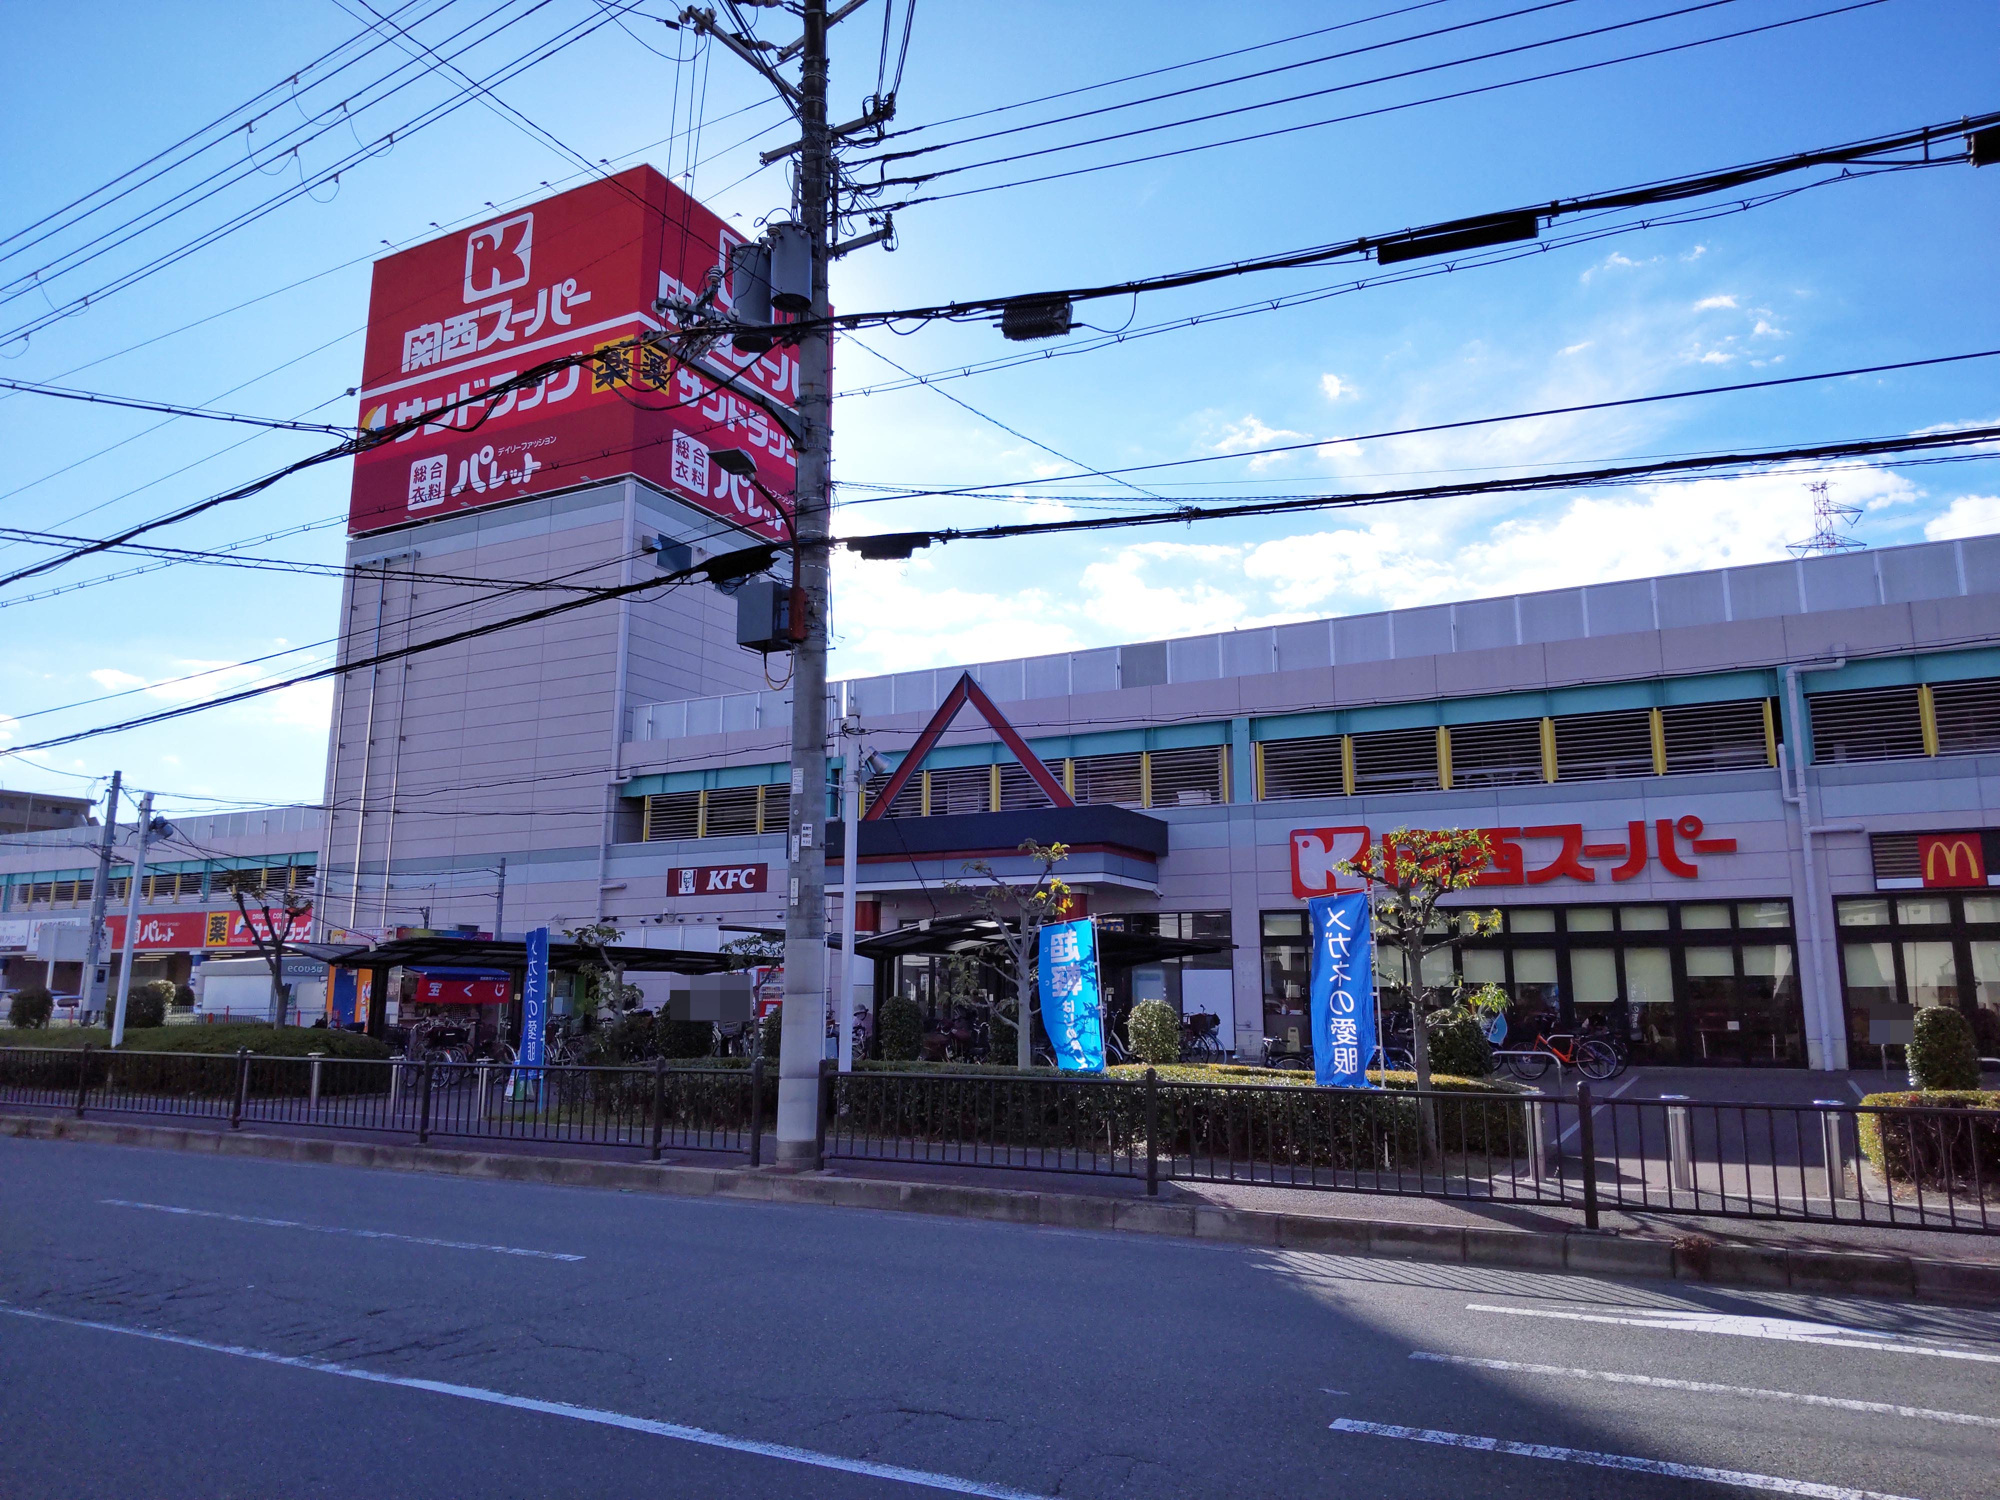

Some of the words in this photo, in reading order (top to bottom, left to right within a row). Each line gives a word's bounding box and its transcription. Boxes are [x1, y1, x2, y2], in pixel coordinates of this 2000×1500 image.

[401, 278, 591, 373] 関西スーパー
[497, 435, 558, 457] デイリーファッション
[675, 437, 706, 470] 総合
[413, 460, 444, 484] 総合
[451, 445, 542, 497] パレット
[674, 460, 706, 490] 衣料
[412, 483, 443, 504] 衣料
[706, 868, 756, 891] KFC
[141, 920, 174, 943] パレット
[209, 915, 228, 943] 薬
[428, 983, 505, 997] 宝くじ
